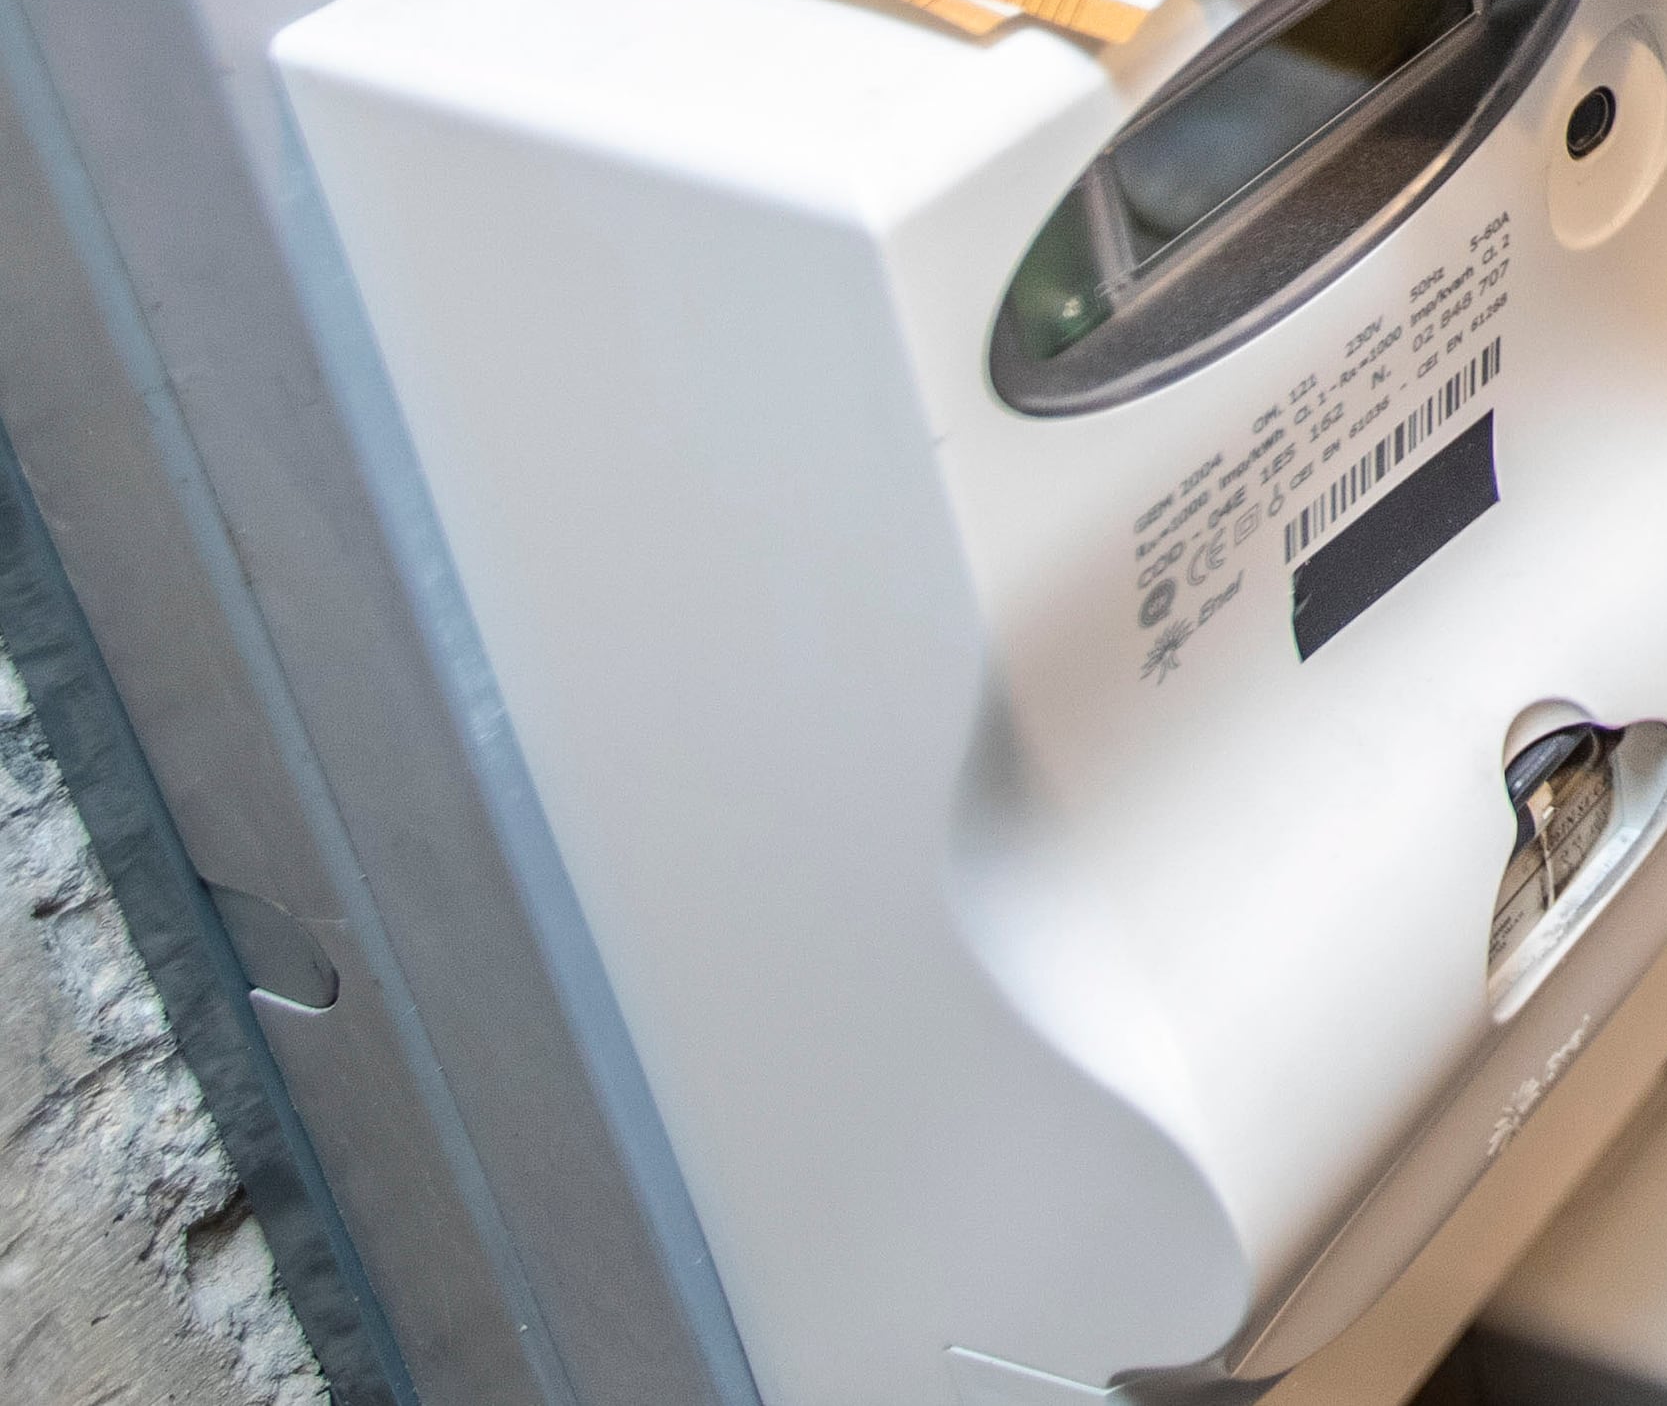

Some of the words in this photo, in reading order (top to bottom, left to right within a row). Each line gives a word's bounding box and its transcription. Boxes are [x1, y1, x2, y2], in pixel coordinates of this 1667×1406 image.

[1345, 315, 1384, 359] 230V
[1409, 266, 1445, 304] 50Hz
[1370, 363, 1393, 391] N.
[1411, 322, 1436, 354] 02
[1478, 256, 1511, 298] 707
[1446, 328, 1465, 356] EN
